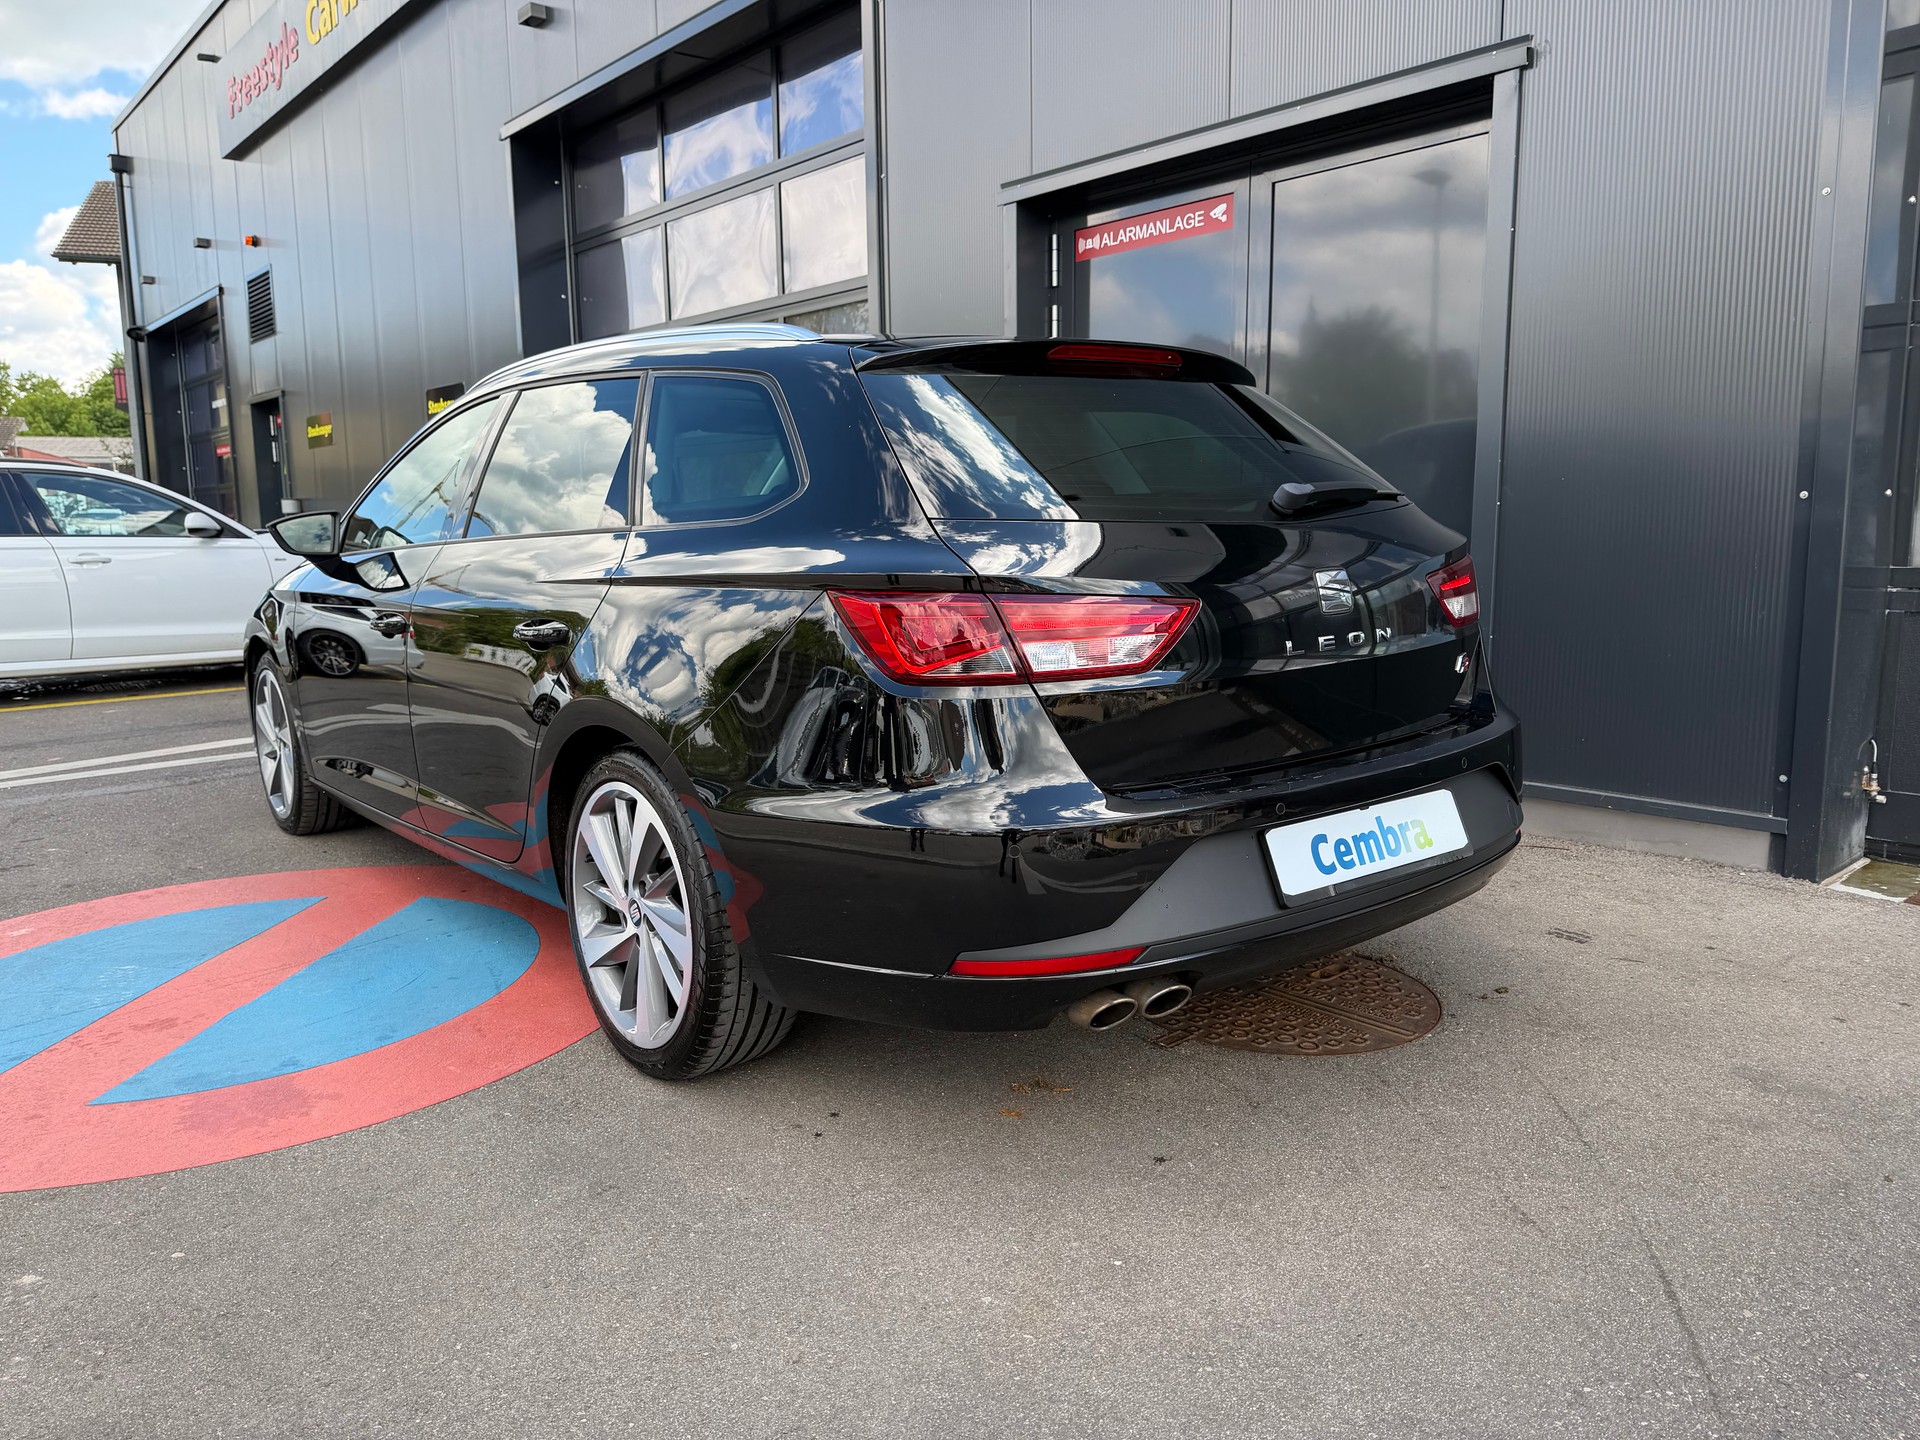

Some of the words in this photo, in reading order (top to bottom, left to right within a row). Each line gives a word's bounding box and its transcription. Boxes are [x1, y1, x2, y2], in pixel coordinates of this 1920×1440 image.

[227, 22, 299, 119] Freestyle
[1100, 211, 1205, 248] ALARMANLAGE
[1285, 627, 1392, 657] LEON
[1310, 815, 1433, 876] Cembra
